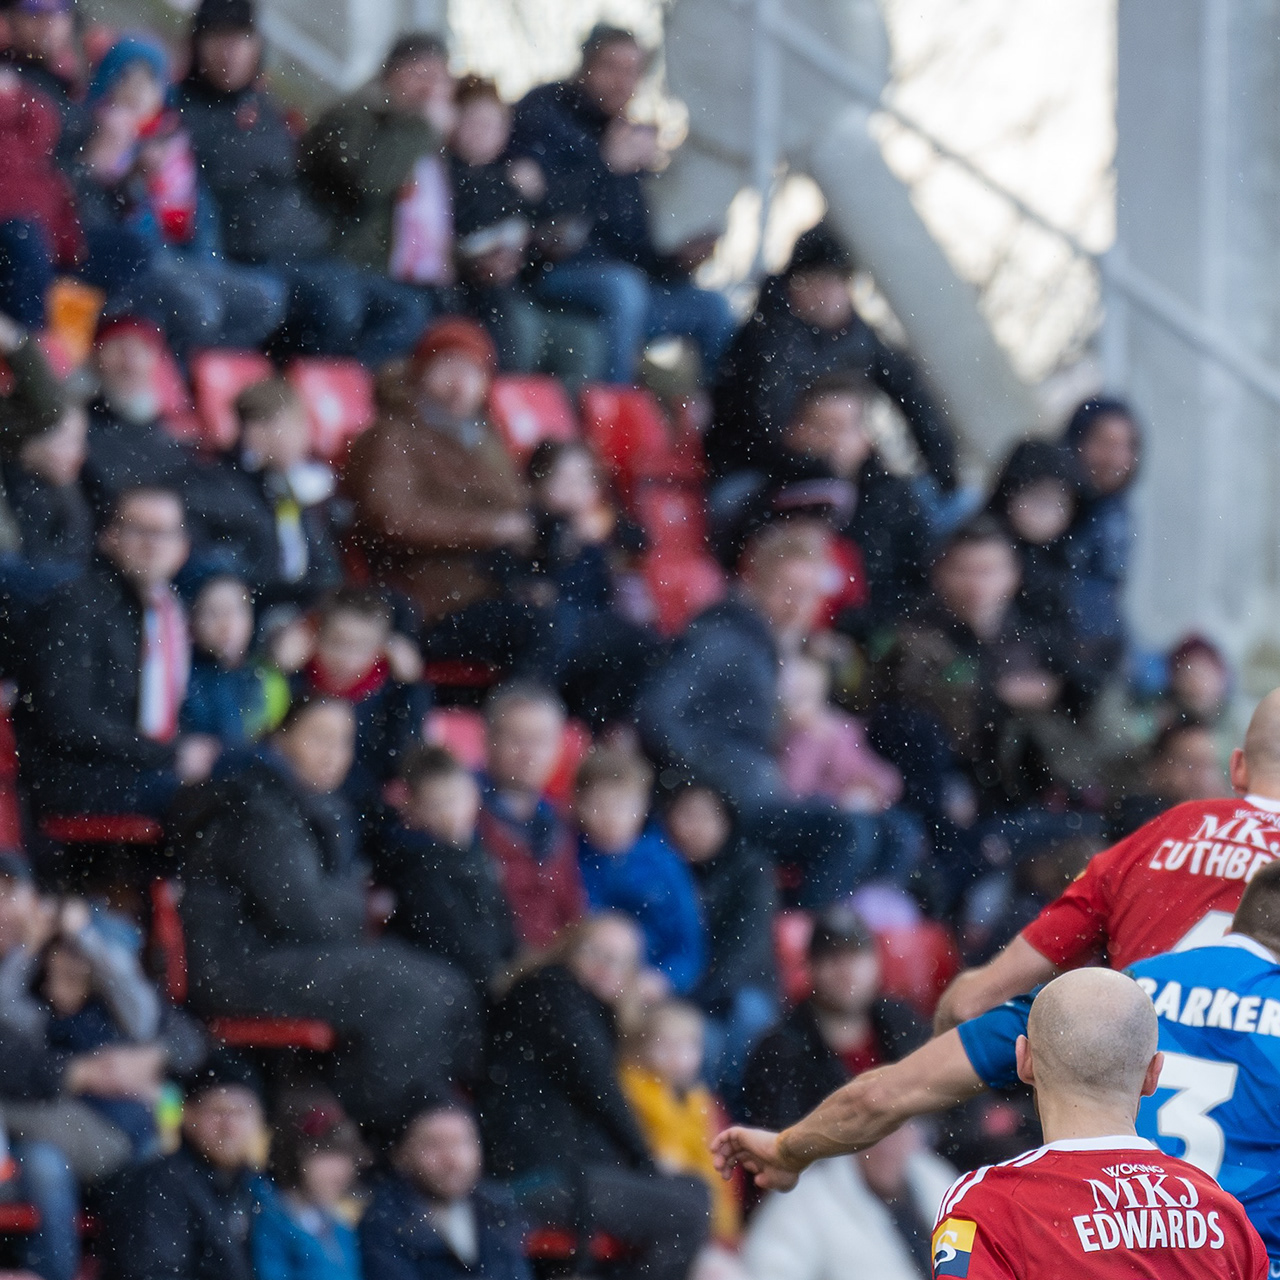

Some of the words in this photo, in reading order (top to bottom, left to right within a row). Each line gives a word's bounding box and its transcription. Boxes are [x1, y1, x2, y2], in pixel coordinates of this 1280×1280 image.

[1149, 839, 1276, 884] CUTHBE
[1101, 1162, 1164, 1178] WOKING
[1082, 1172, 1199, 1213] MKJ
[1072, 1208, 1225, 1253] EDWARDS
